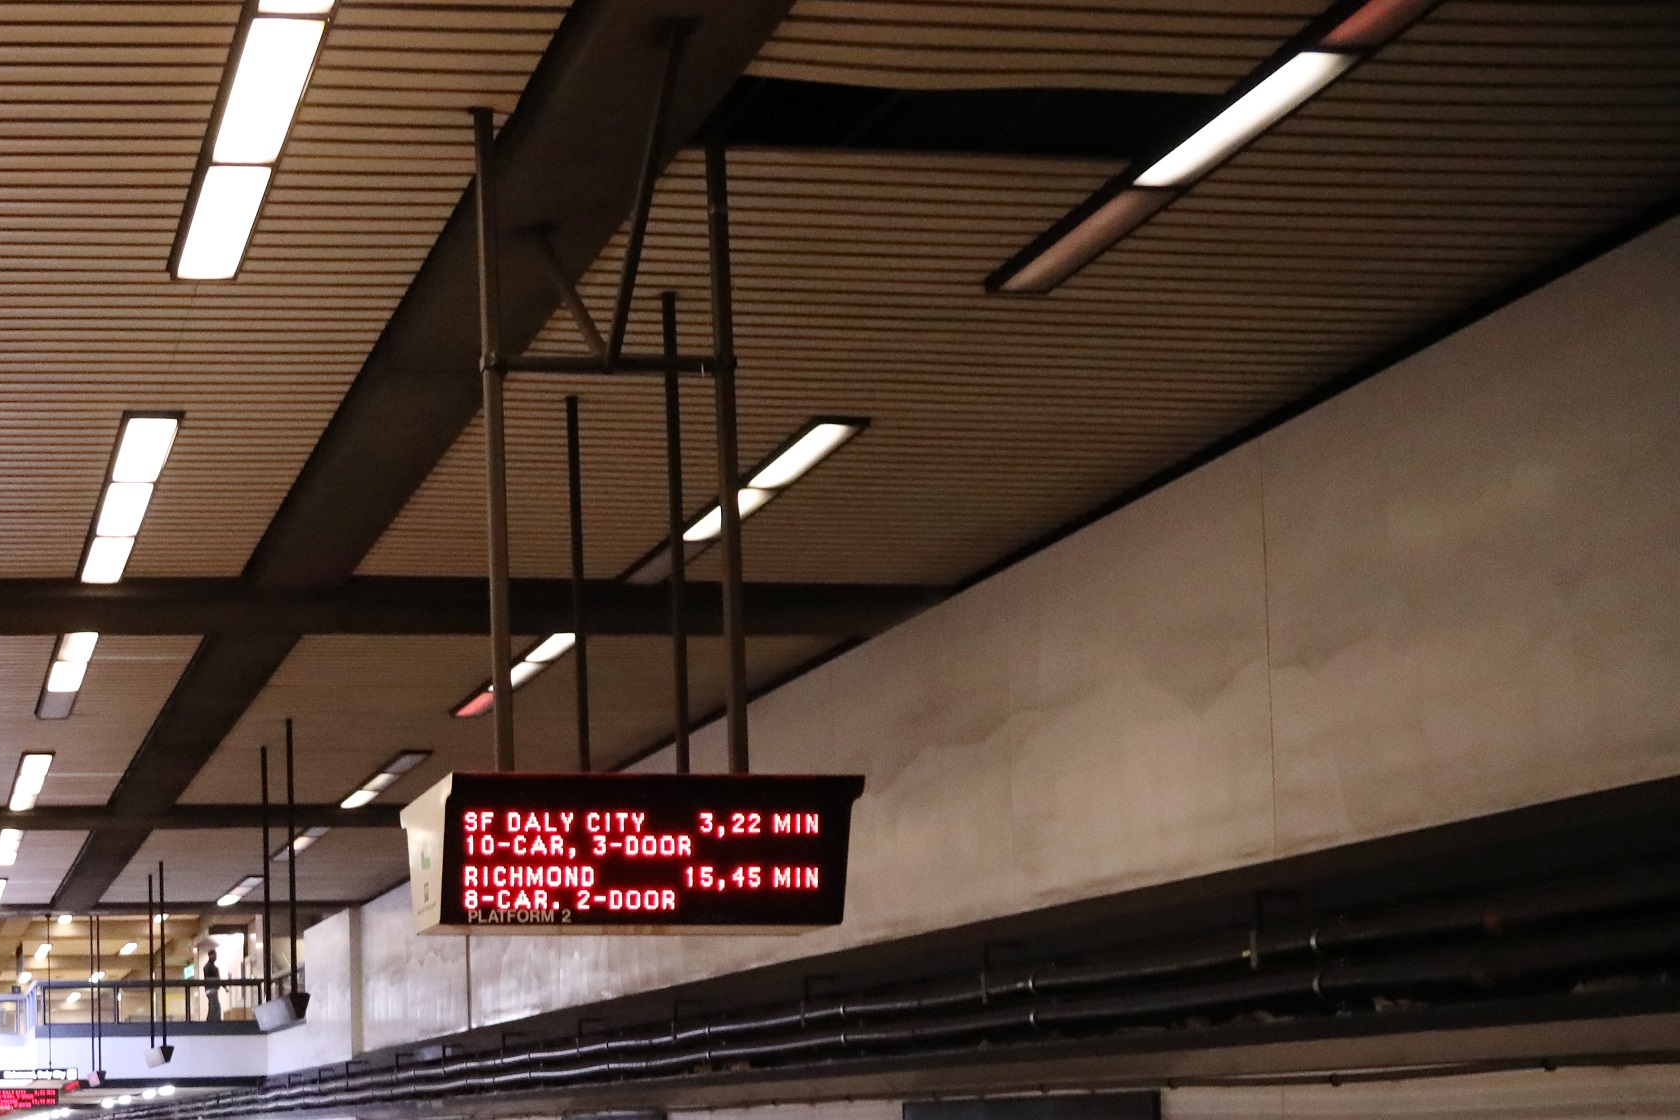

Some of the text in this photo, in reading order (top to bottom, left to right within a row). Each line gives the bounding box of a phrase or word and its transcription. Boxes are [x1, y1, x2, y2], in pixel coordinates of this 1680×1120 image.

[464, 811, 819, 838] SF DALY CITY 3,22 MIN
[466, 834, 692, 859] 10-CAR, 3-DOOR
[464, 866, 819, 891] RICHMOND 15,45 MIN
[577, 890, 675, 910] 2-DOOR
[468, 909, 571, 924] PLATFORM 2
